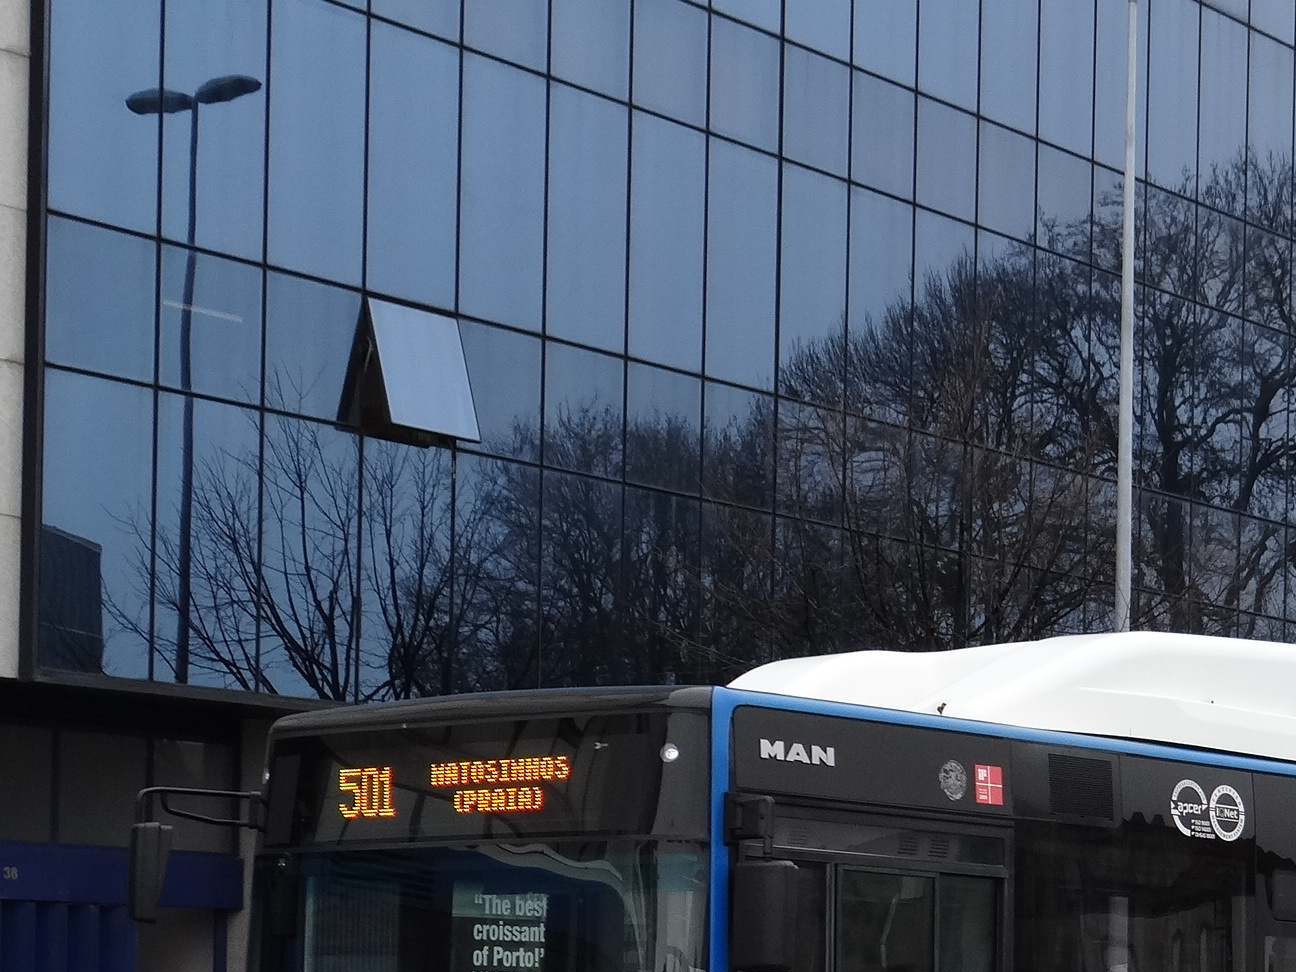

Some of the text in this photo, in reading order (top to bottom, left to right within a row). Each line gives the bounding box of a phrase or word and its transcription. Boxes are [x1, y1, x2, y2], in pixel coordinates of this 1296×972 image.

[760, 738, 836, 767] MAN
[430, 755, 571, 786] MATOSINHOS
[338, 766, 397, 818] 501
[453, 786, 544, 813] (PRAIA)
[1177, 801, 1202, 817] apcer
[473, 921, 546, 942] croissant
[473, 945, 489, 967] of
